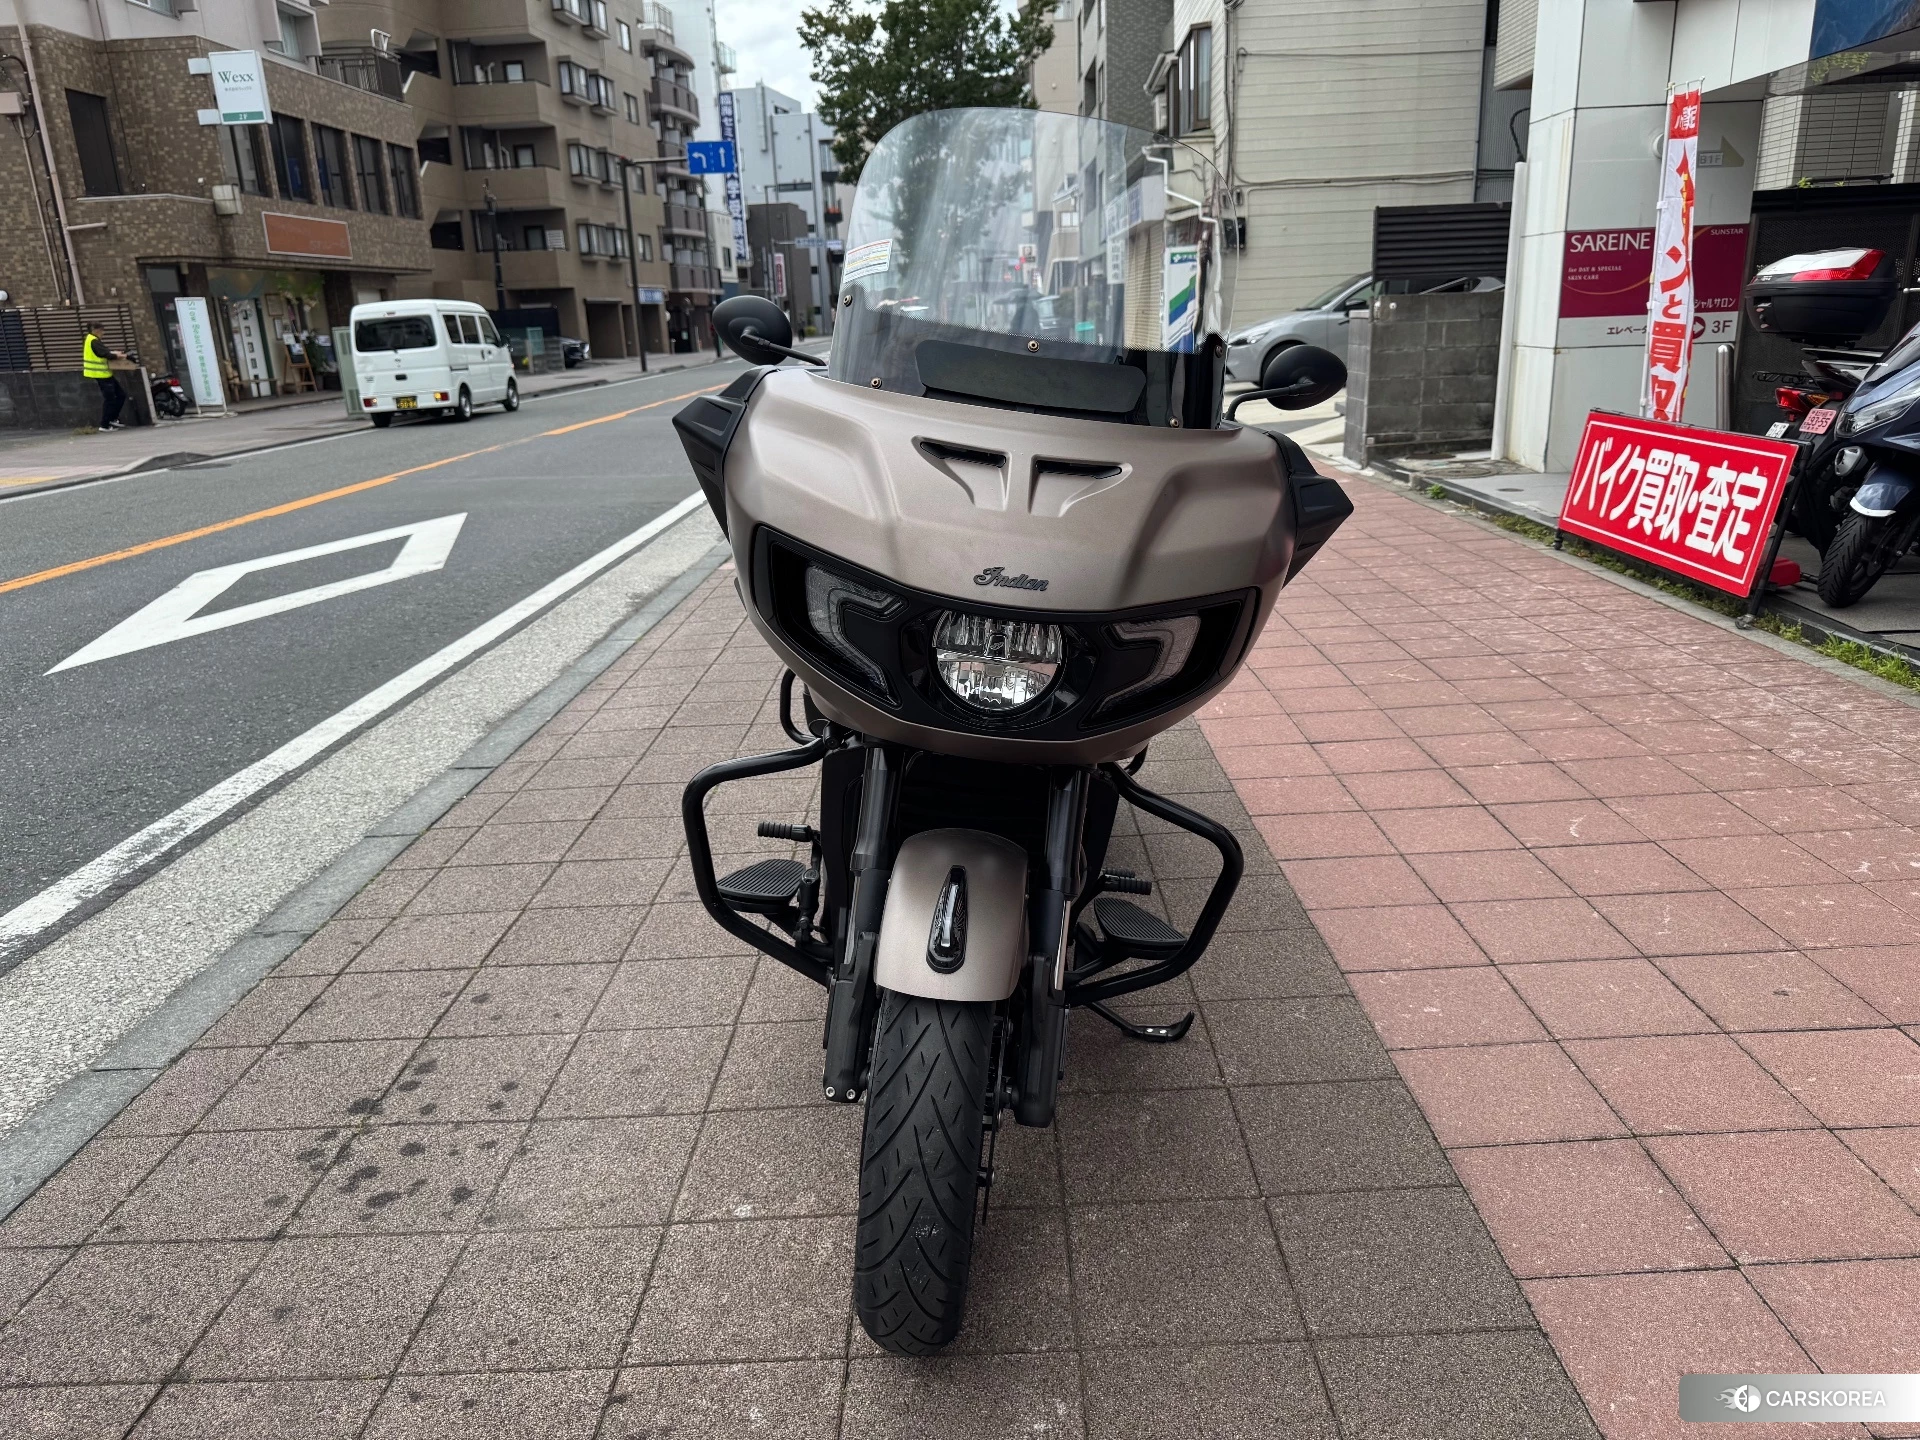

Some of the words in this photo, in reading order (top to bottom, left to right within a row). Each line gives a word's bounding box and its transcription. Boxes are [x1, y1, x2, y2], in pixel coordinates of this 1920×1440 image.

[219, 71, 254, 83] Wexx
[1700, 154, 1721, 164] B1F
[1570, 232, 1651, 253] SAREINE
[1711, 320, 1733, 333] 3F
[1573, 437, 1768, 565] バイク買取・査定
[973, 566, 1050, 592] Indian
